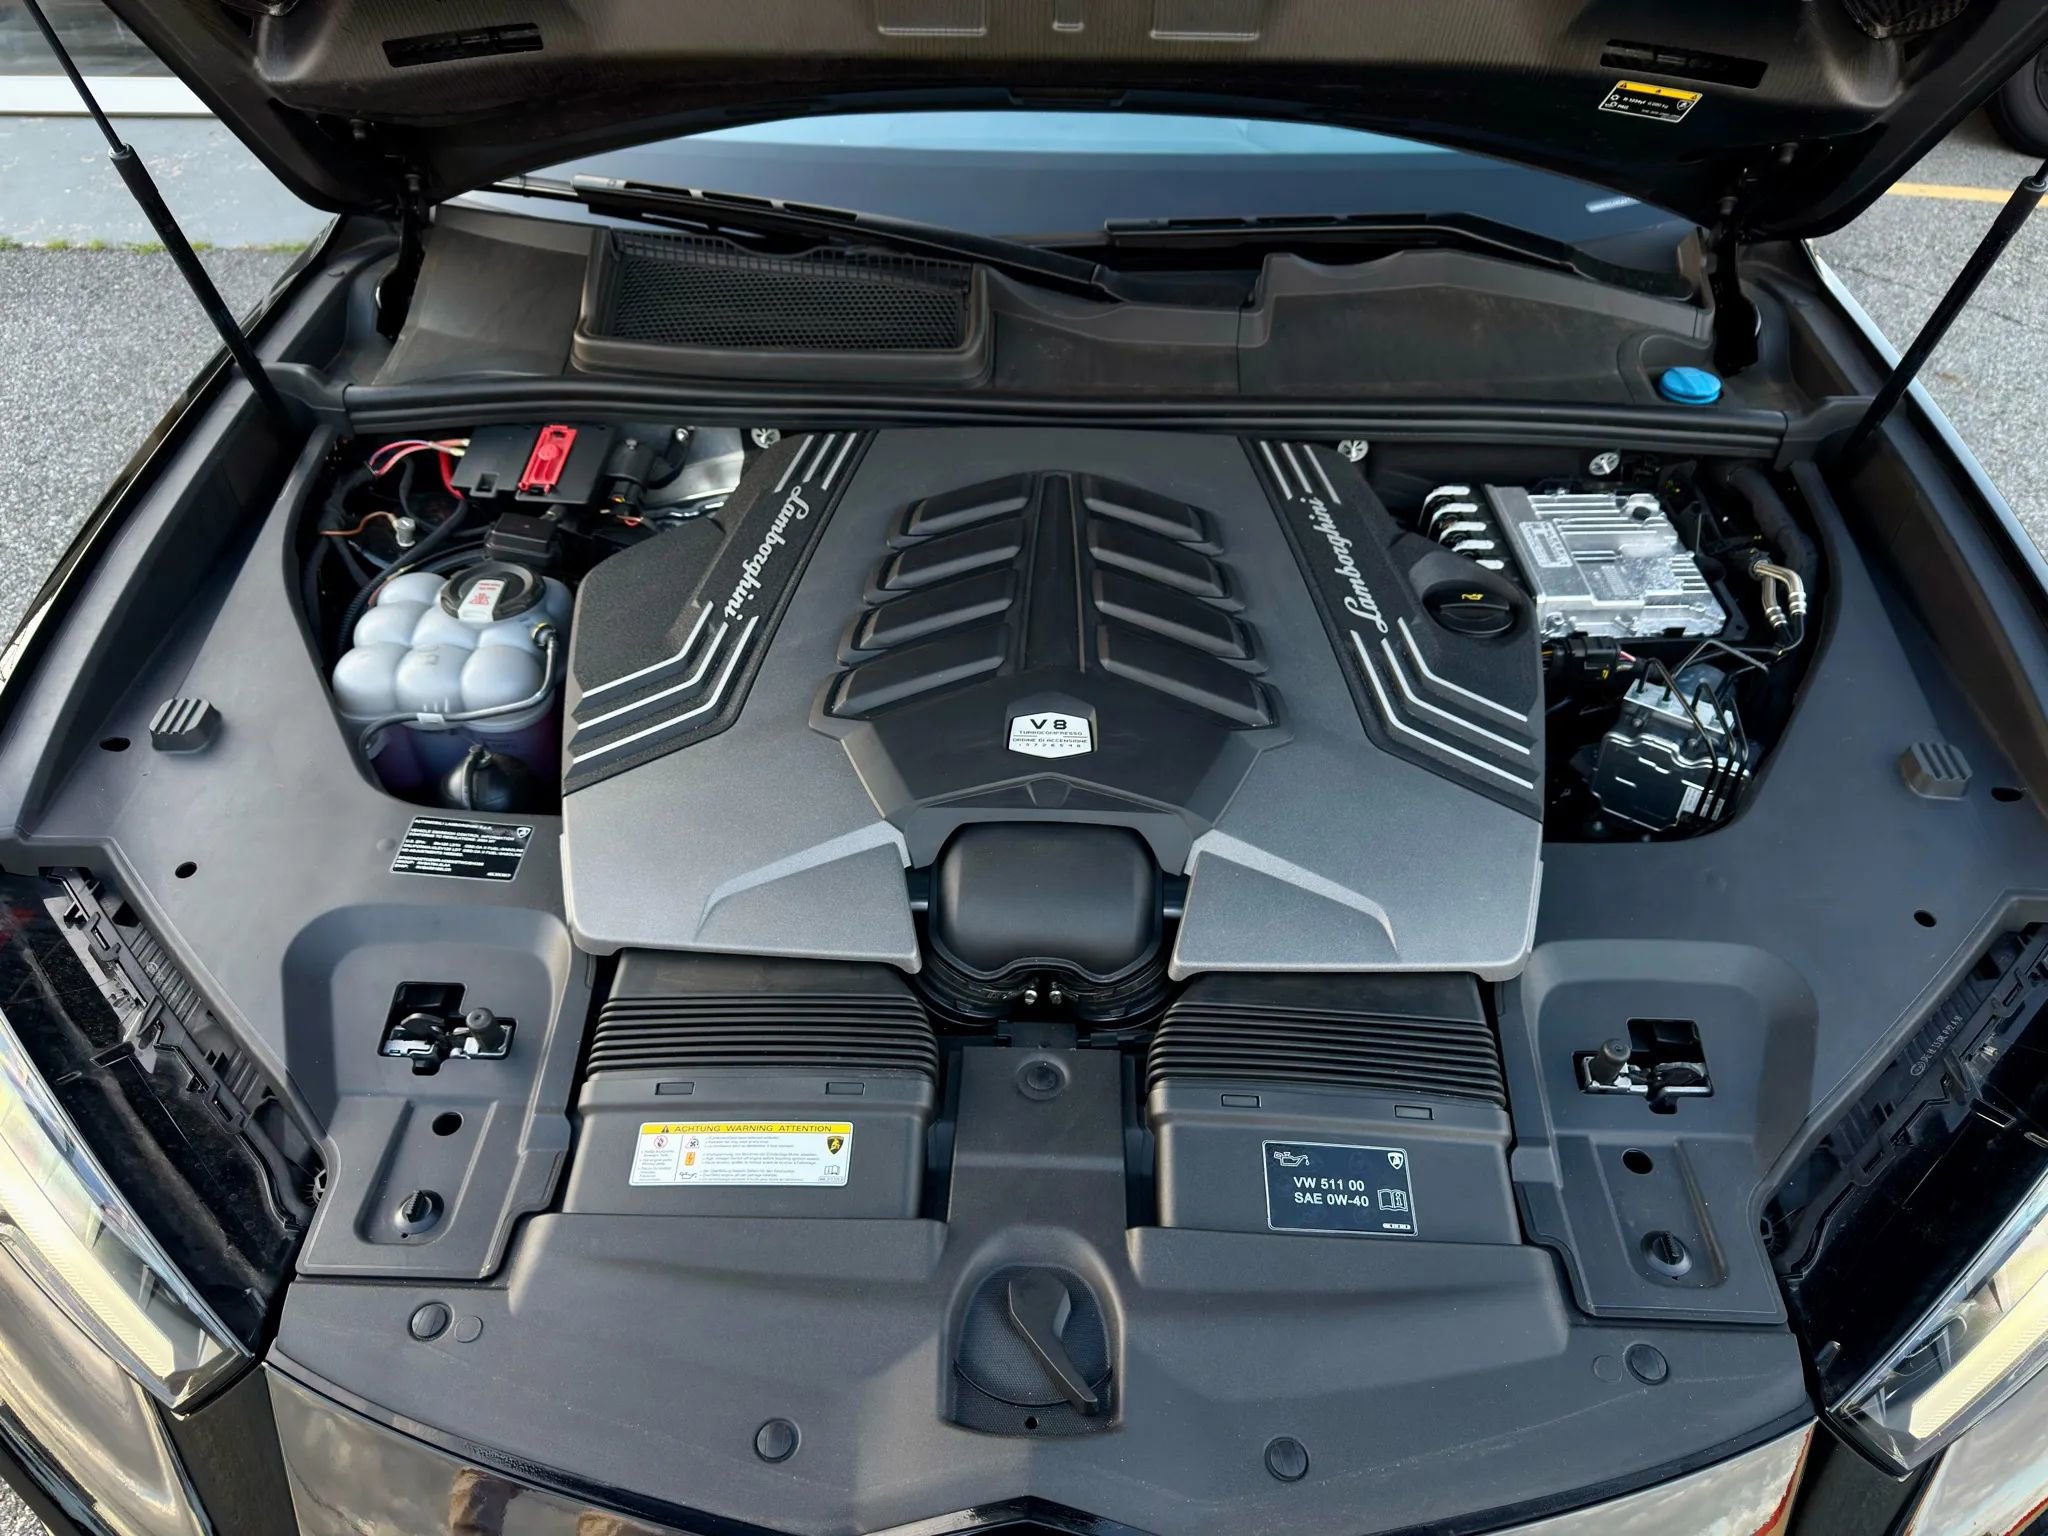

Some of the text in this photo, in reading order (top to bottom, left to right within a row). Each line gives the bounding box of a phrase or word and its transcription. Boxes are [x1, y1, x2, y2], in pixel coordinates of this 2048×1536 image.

[724, 485, 810, 621] Lamborghini
[1299, 496, 1389, 634] Lamborghini
[674, 1125, 832, 1133] ACHTUNG WARNING ATTENTION
[1293, 1176, 1365, 1191] VW 511 00
[1294, 1192, 1369, 1207] SAE 0W-40
